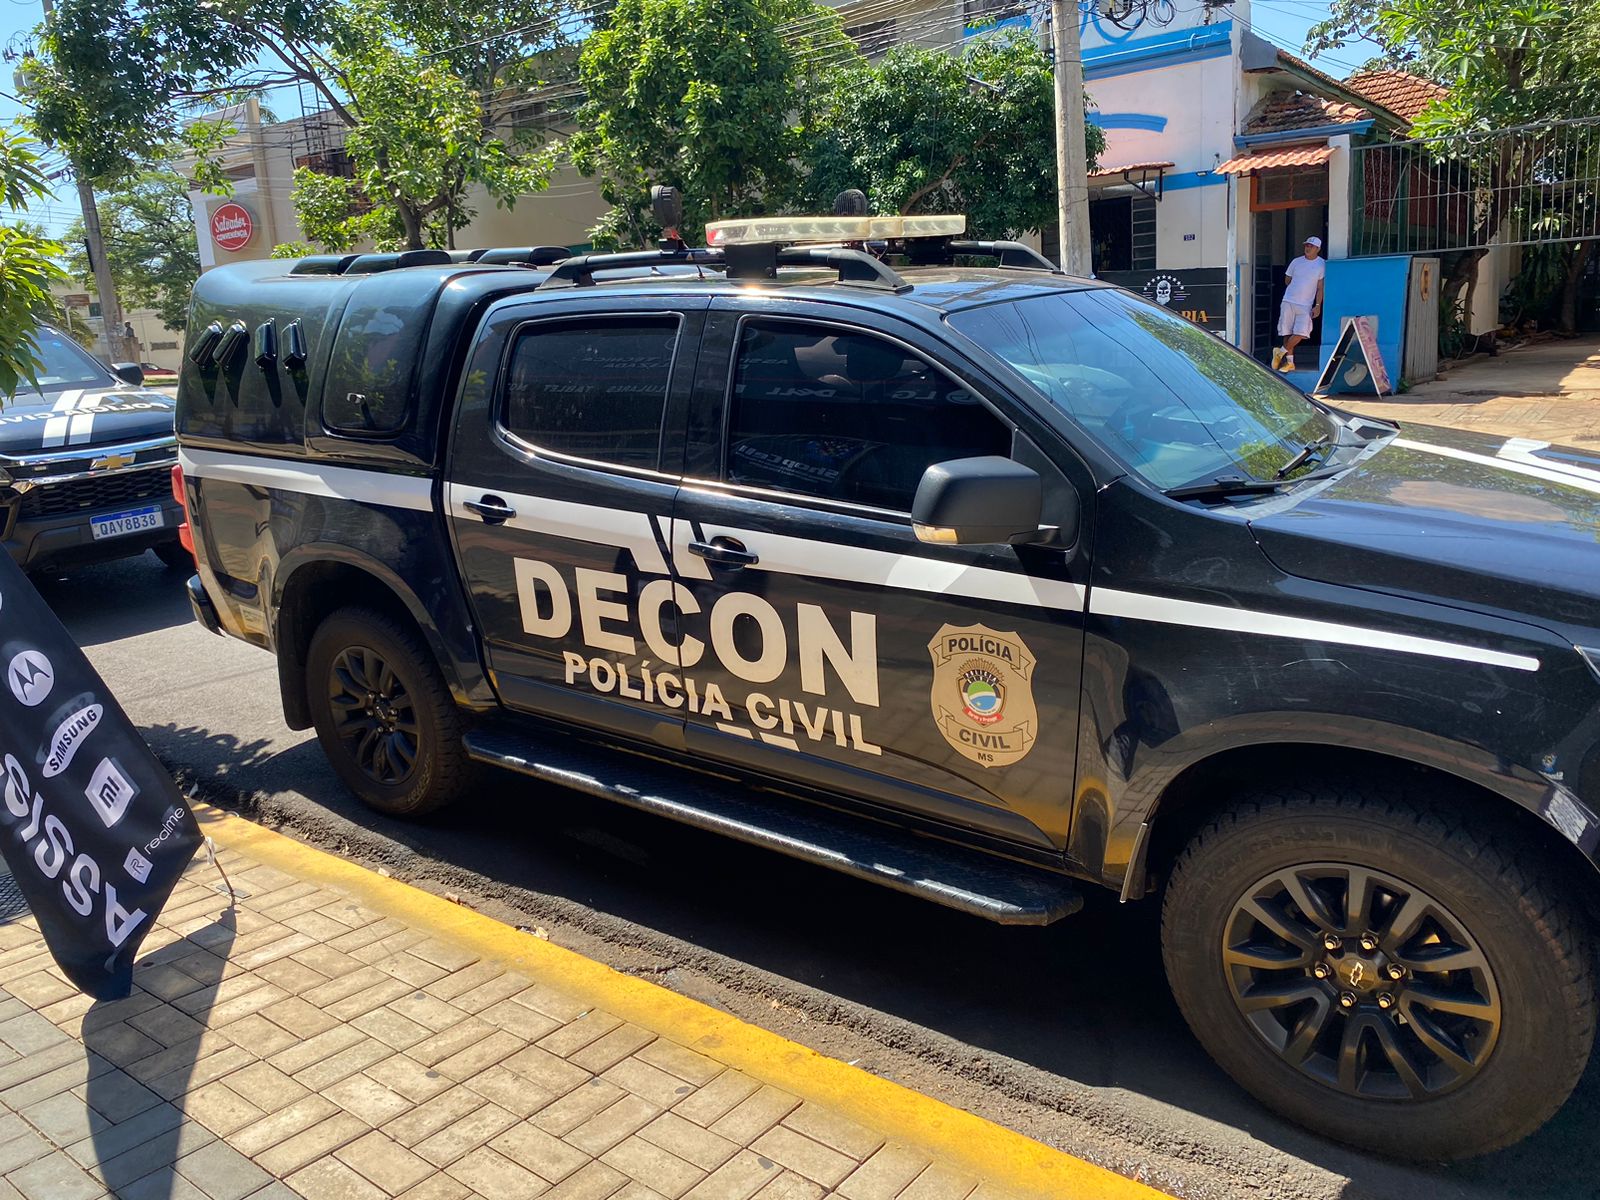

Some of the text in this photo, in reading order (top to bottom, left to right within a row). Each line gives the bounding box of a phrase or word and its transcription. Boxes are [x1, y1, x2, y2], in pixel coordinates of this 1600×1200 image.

[100, 514, 156, 536] QAY8B38
[513, 557, 880, 707] DECON
[948, 636, 1013, 661] POLÍCIA
[563, 650, 883, 756] POLÍCIA CIVIL
[49, 709, 98, 772] SAMSUNG
[959, 728, 1011, 749] CIVIL
[977, 752, 994, 762] MS
[144, 807, 185, 855] realme
